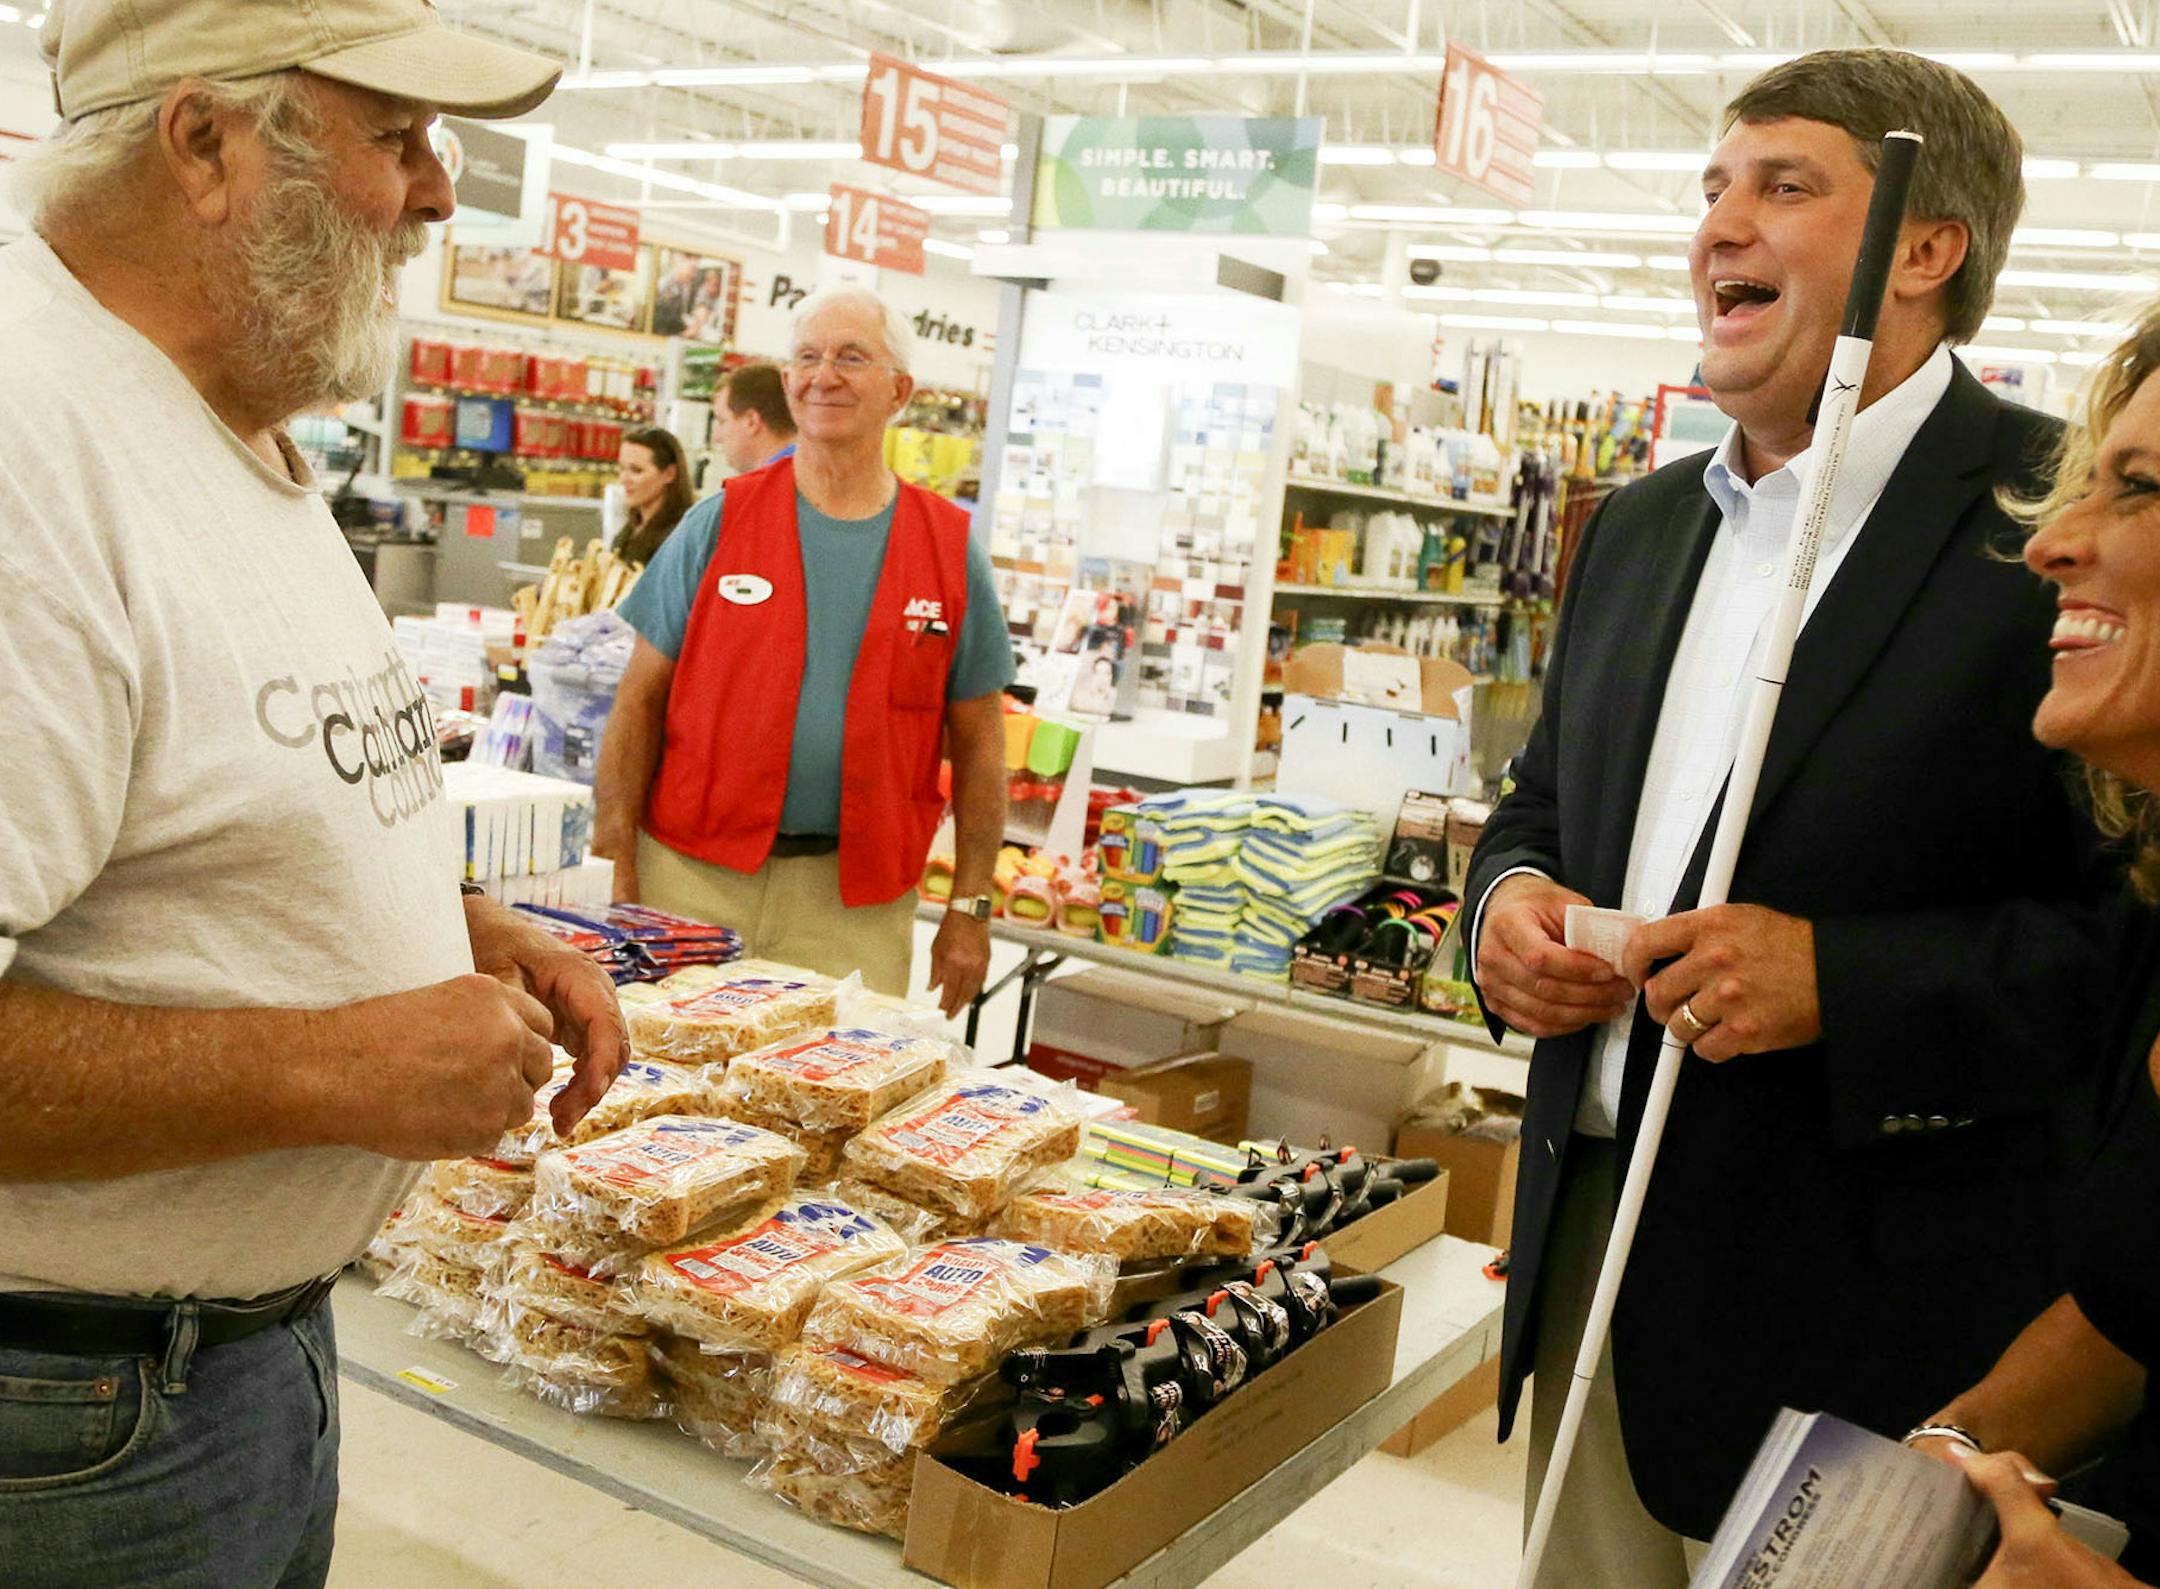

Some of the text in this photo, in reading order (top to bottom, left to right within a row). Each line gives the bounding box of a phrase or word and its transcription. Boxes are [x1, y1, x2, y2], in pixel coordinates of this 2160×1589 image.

[871, 67, 939, 170] 15
[1446, 58, 1498, 178] 16
[1079, 147, 1276, 171] SIMPLE. SMART.
[1099, 176, 1248, 201] BEAUTIFUL.
[831, 191, 878, 261] 14
[1088, 335, 1245, 362] KENSINGTON
[1799, 566, 1810, 590] BLIND
[903, 596, 943, 619] ACE
[744, 1239, 803, 1261] AUTO
[925, 1264, 984, 1284] AUTO
